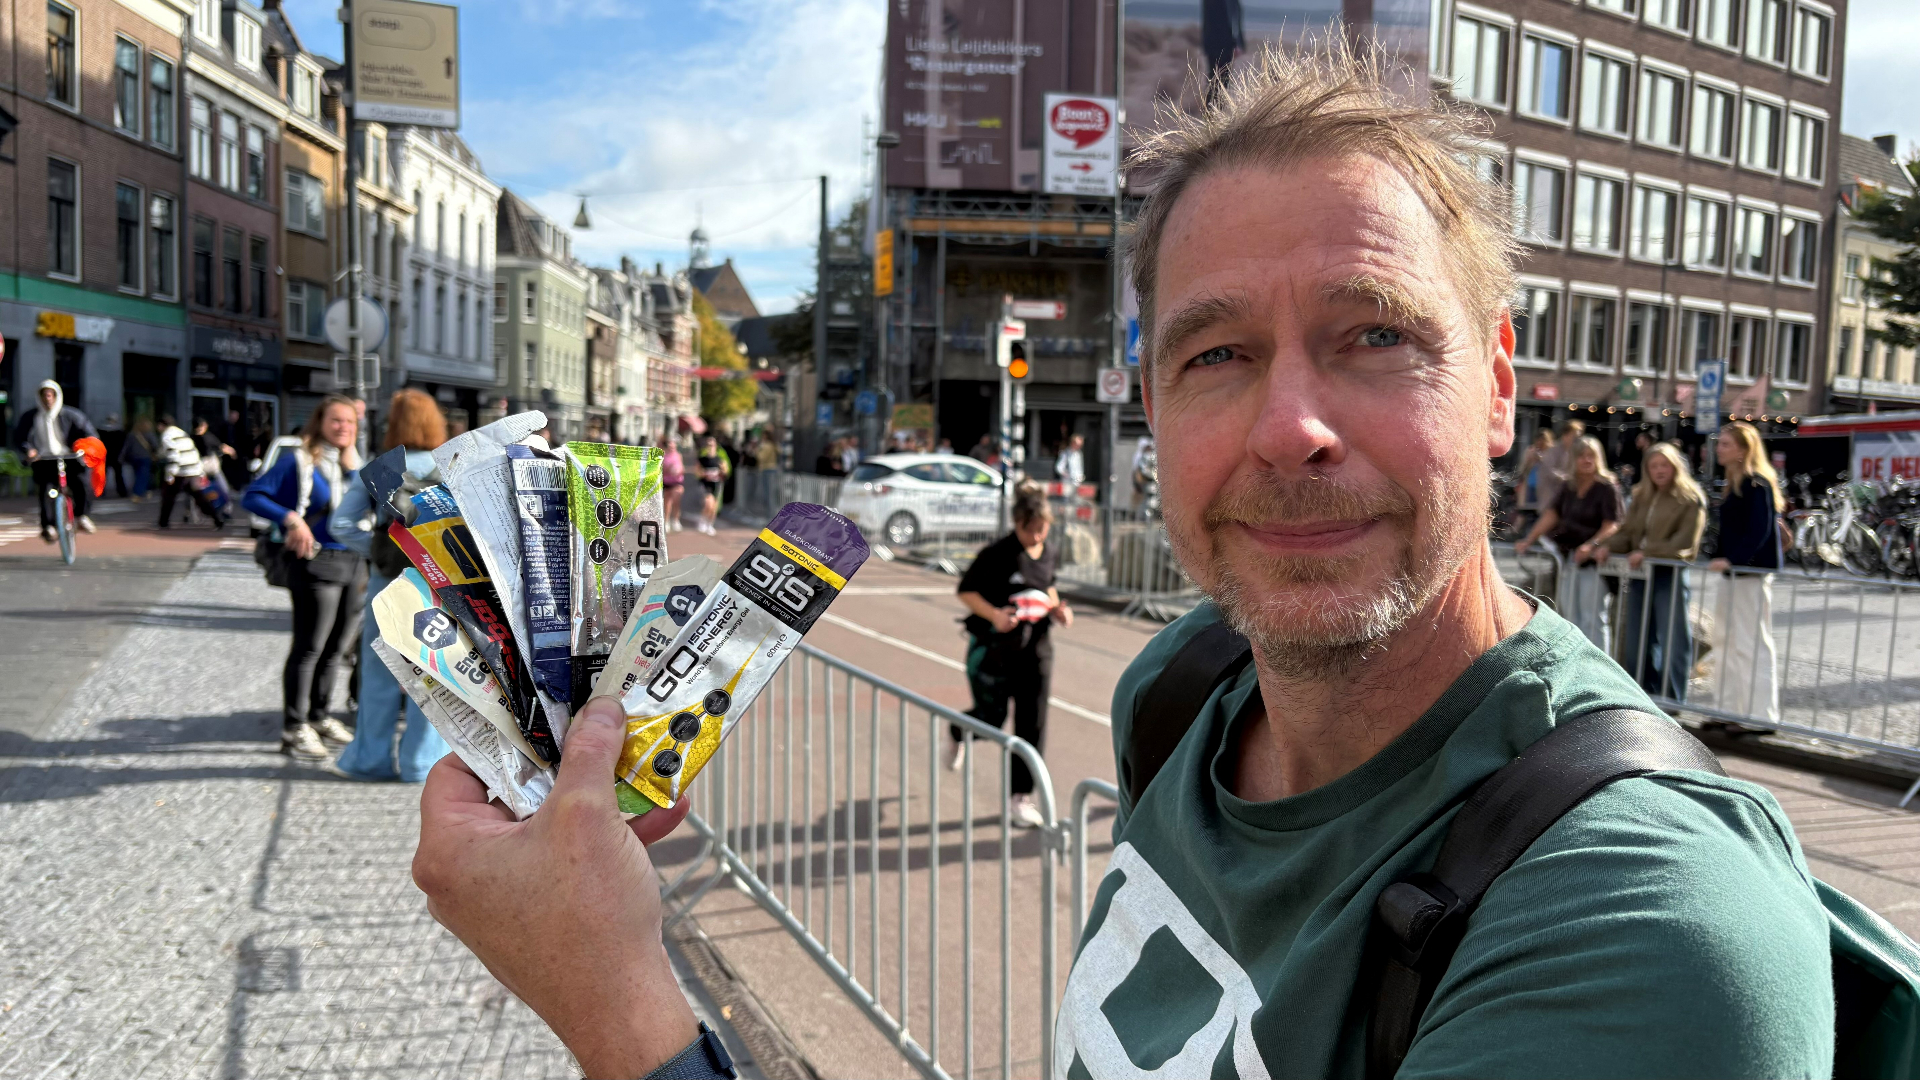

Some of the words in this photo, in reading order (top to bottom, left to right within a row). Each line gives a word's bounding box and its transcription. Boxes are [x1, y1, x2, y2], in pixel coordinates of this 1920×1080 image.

[421, 493, 442, 516] BLACK
[635, 520, 660, 578] GO
[780, 543, 820, 572] ISOTONIC
[784, 529, 834, 563] BLACKCURRANT
[421, 553, 447, 582] CAFFEINE
[734, 579, 763, 602] SCIENCE
[762, 598, 771, 607] IN
[770, 603, 796, 623] SPORT
[422, 612, 450, 643] GU
[687, 594, 732, 646] ISOTONIC
[697, 600, 739, 653] ENERGY
[726, 618, 745, 637] Energy
[740, 607, 751, 620] Gel
[646, 626, 674, 647] Ene
[454, 647, 481, 675] Ener
[468, 662, 492, 684] Ge
[591, 658, 609, 666] ORT
[634, 655, 651, 670] Dieta
[646, 645, 699, 702] GO
[482, 677, 497, 694] Dieta
